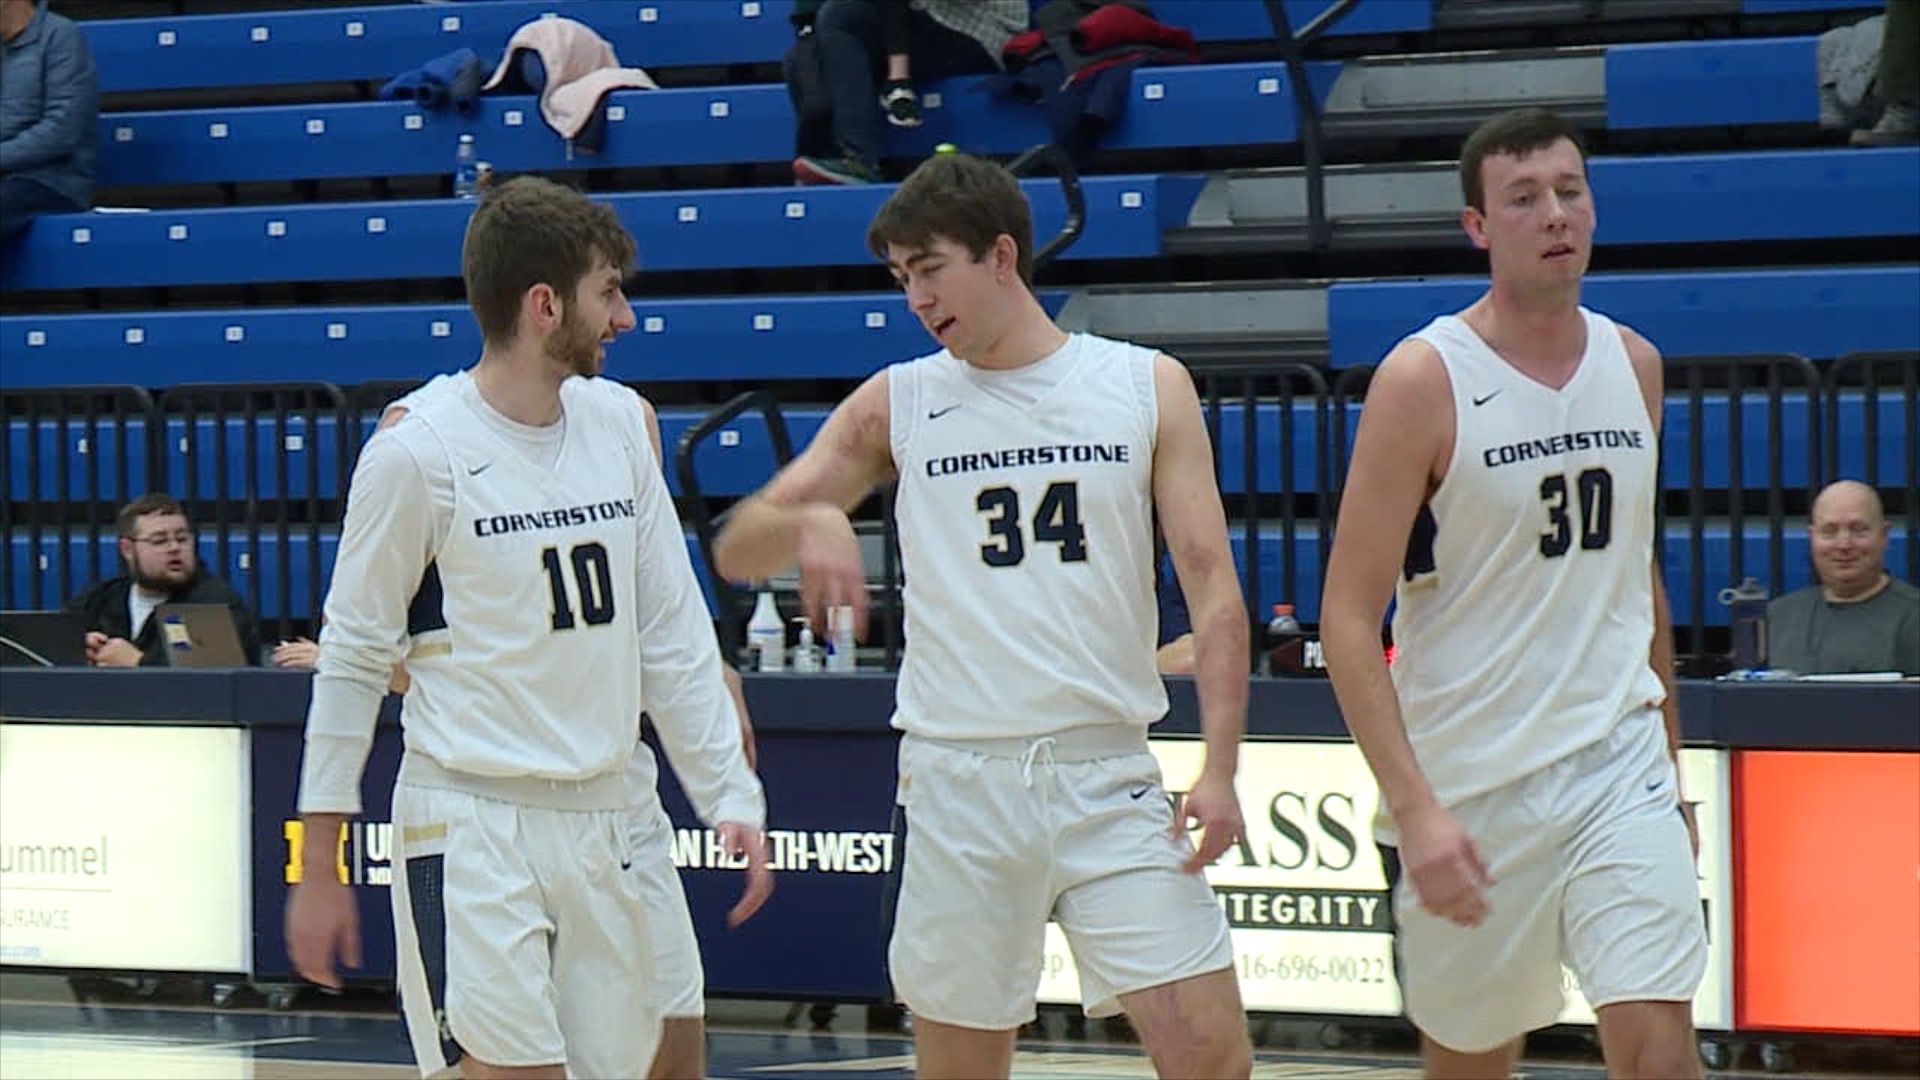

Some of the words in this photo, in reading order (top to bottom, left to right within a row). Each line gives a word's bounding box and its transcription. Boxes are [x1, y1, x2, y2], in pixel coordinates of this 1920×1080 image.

[926, 444, 1129, 476] CORNERSTONE
[1484, 429, 1644, 467] CORNERSTONE
[976, 480, 1087, 567] 34
[1539, 467, 1613, 559] 30
[541, 541, 615, 631] 10
